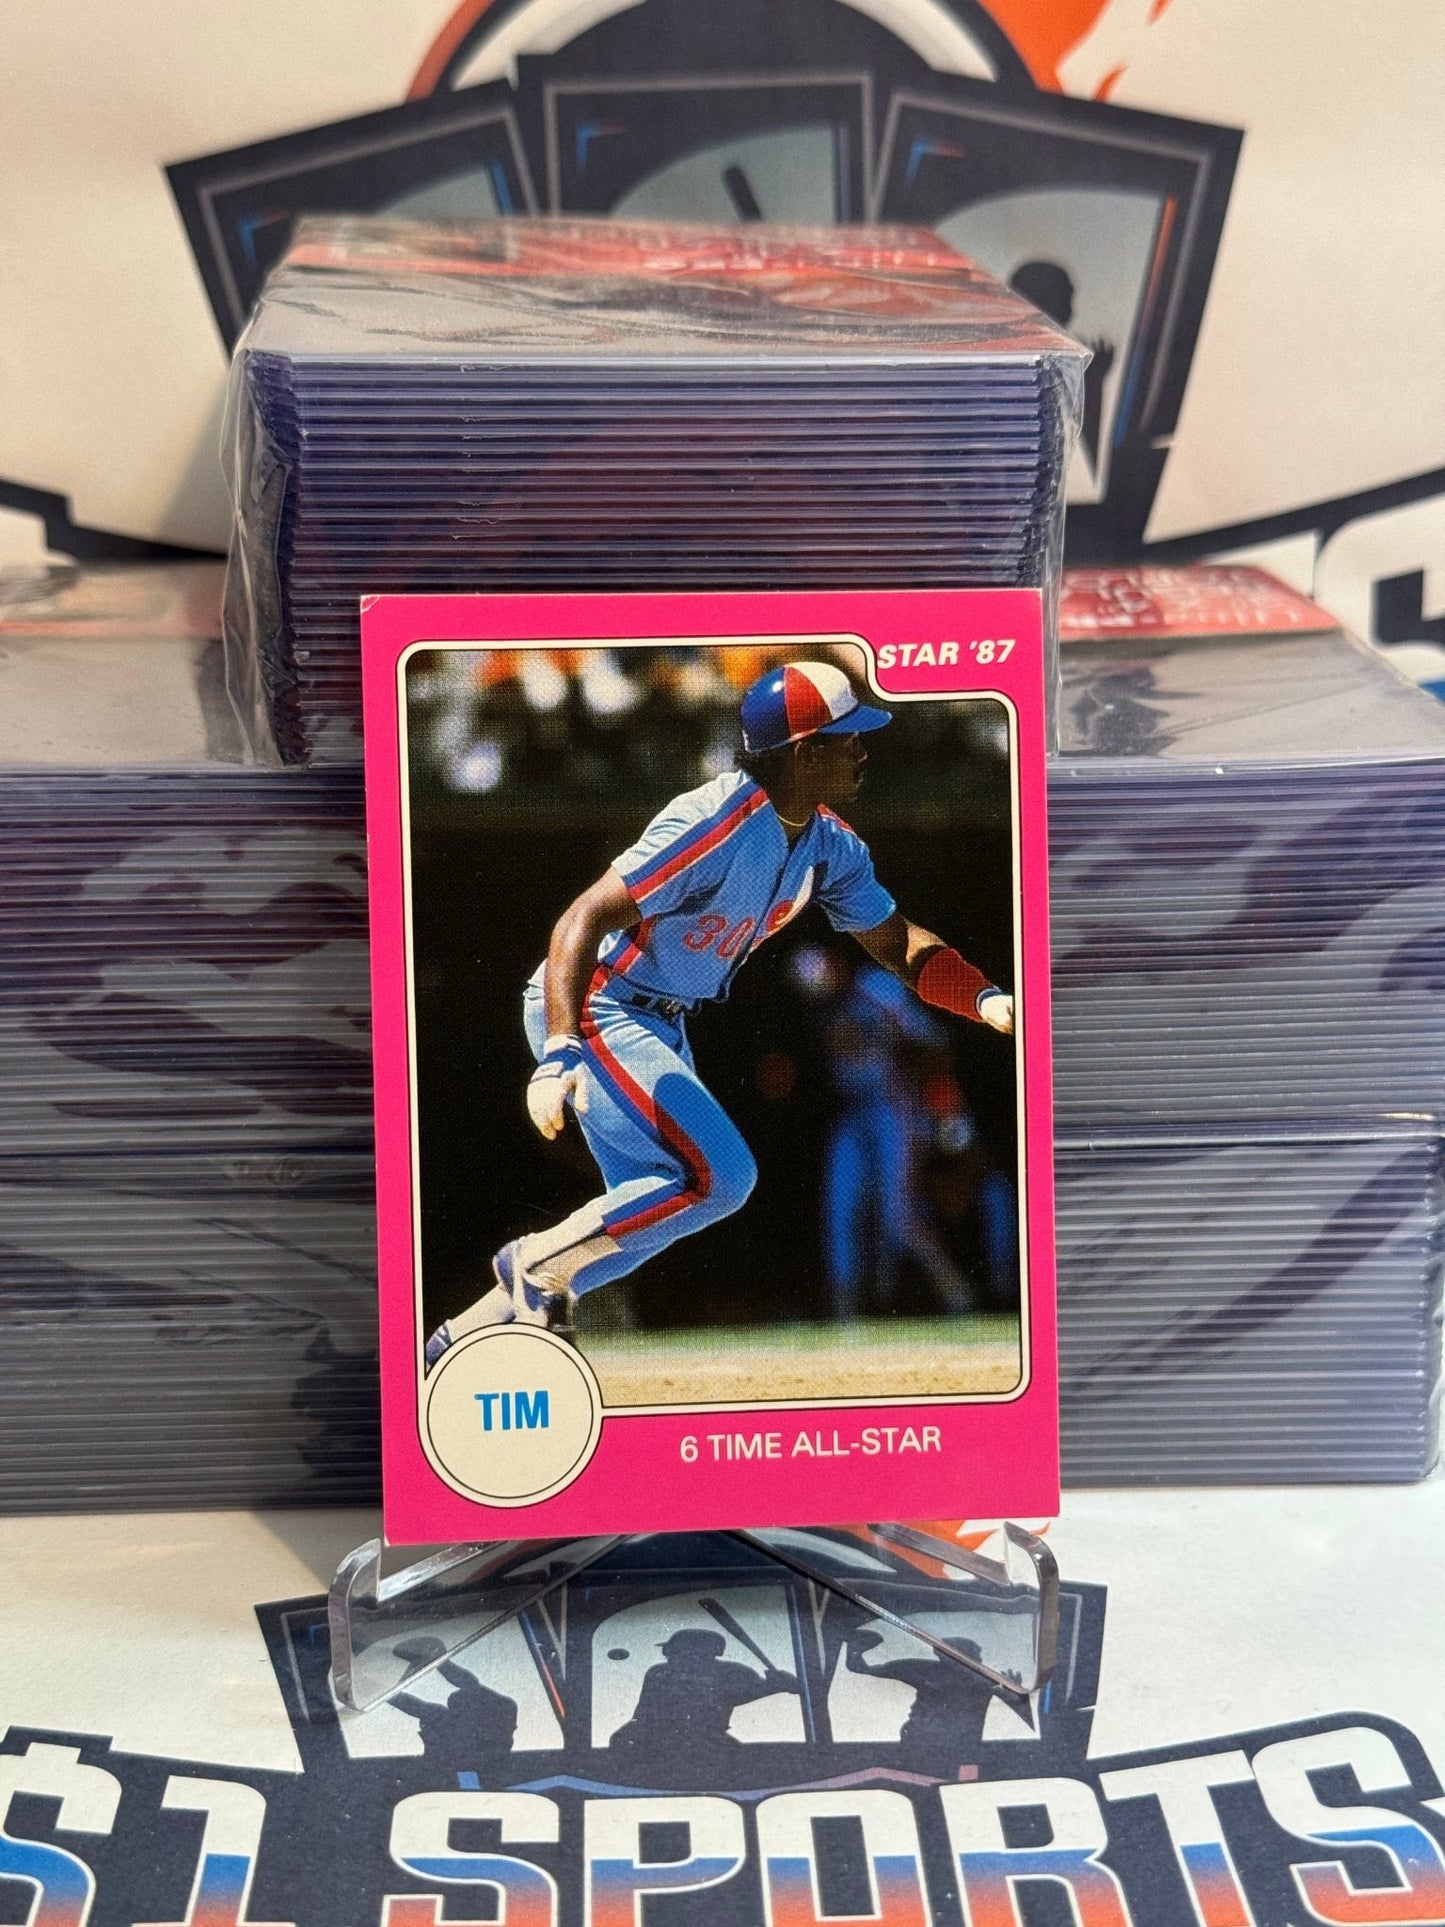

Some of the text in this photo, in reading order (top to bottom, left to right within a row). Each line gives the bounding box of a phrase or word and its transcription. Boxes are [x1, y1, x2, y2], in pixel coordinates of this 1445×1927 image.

[876, 639, 1016, 670] STAR '87
[682, 912, 756, 961] 30
[474, 1390, 550, 1432] TIM
[680, 1425, 942, 1463] 6 TIME ALL-STAR
[380, 1726, 1445, 1927] SPORTS
